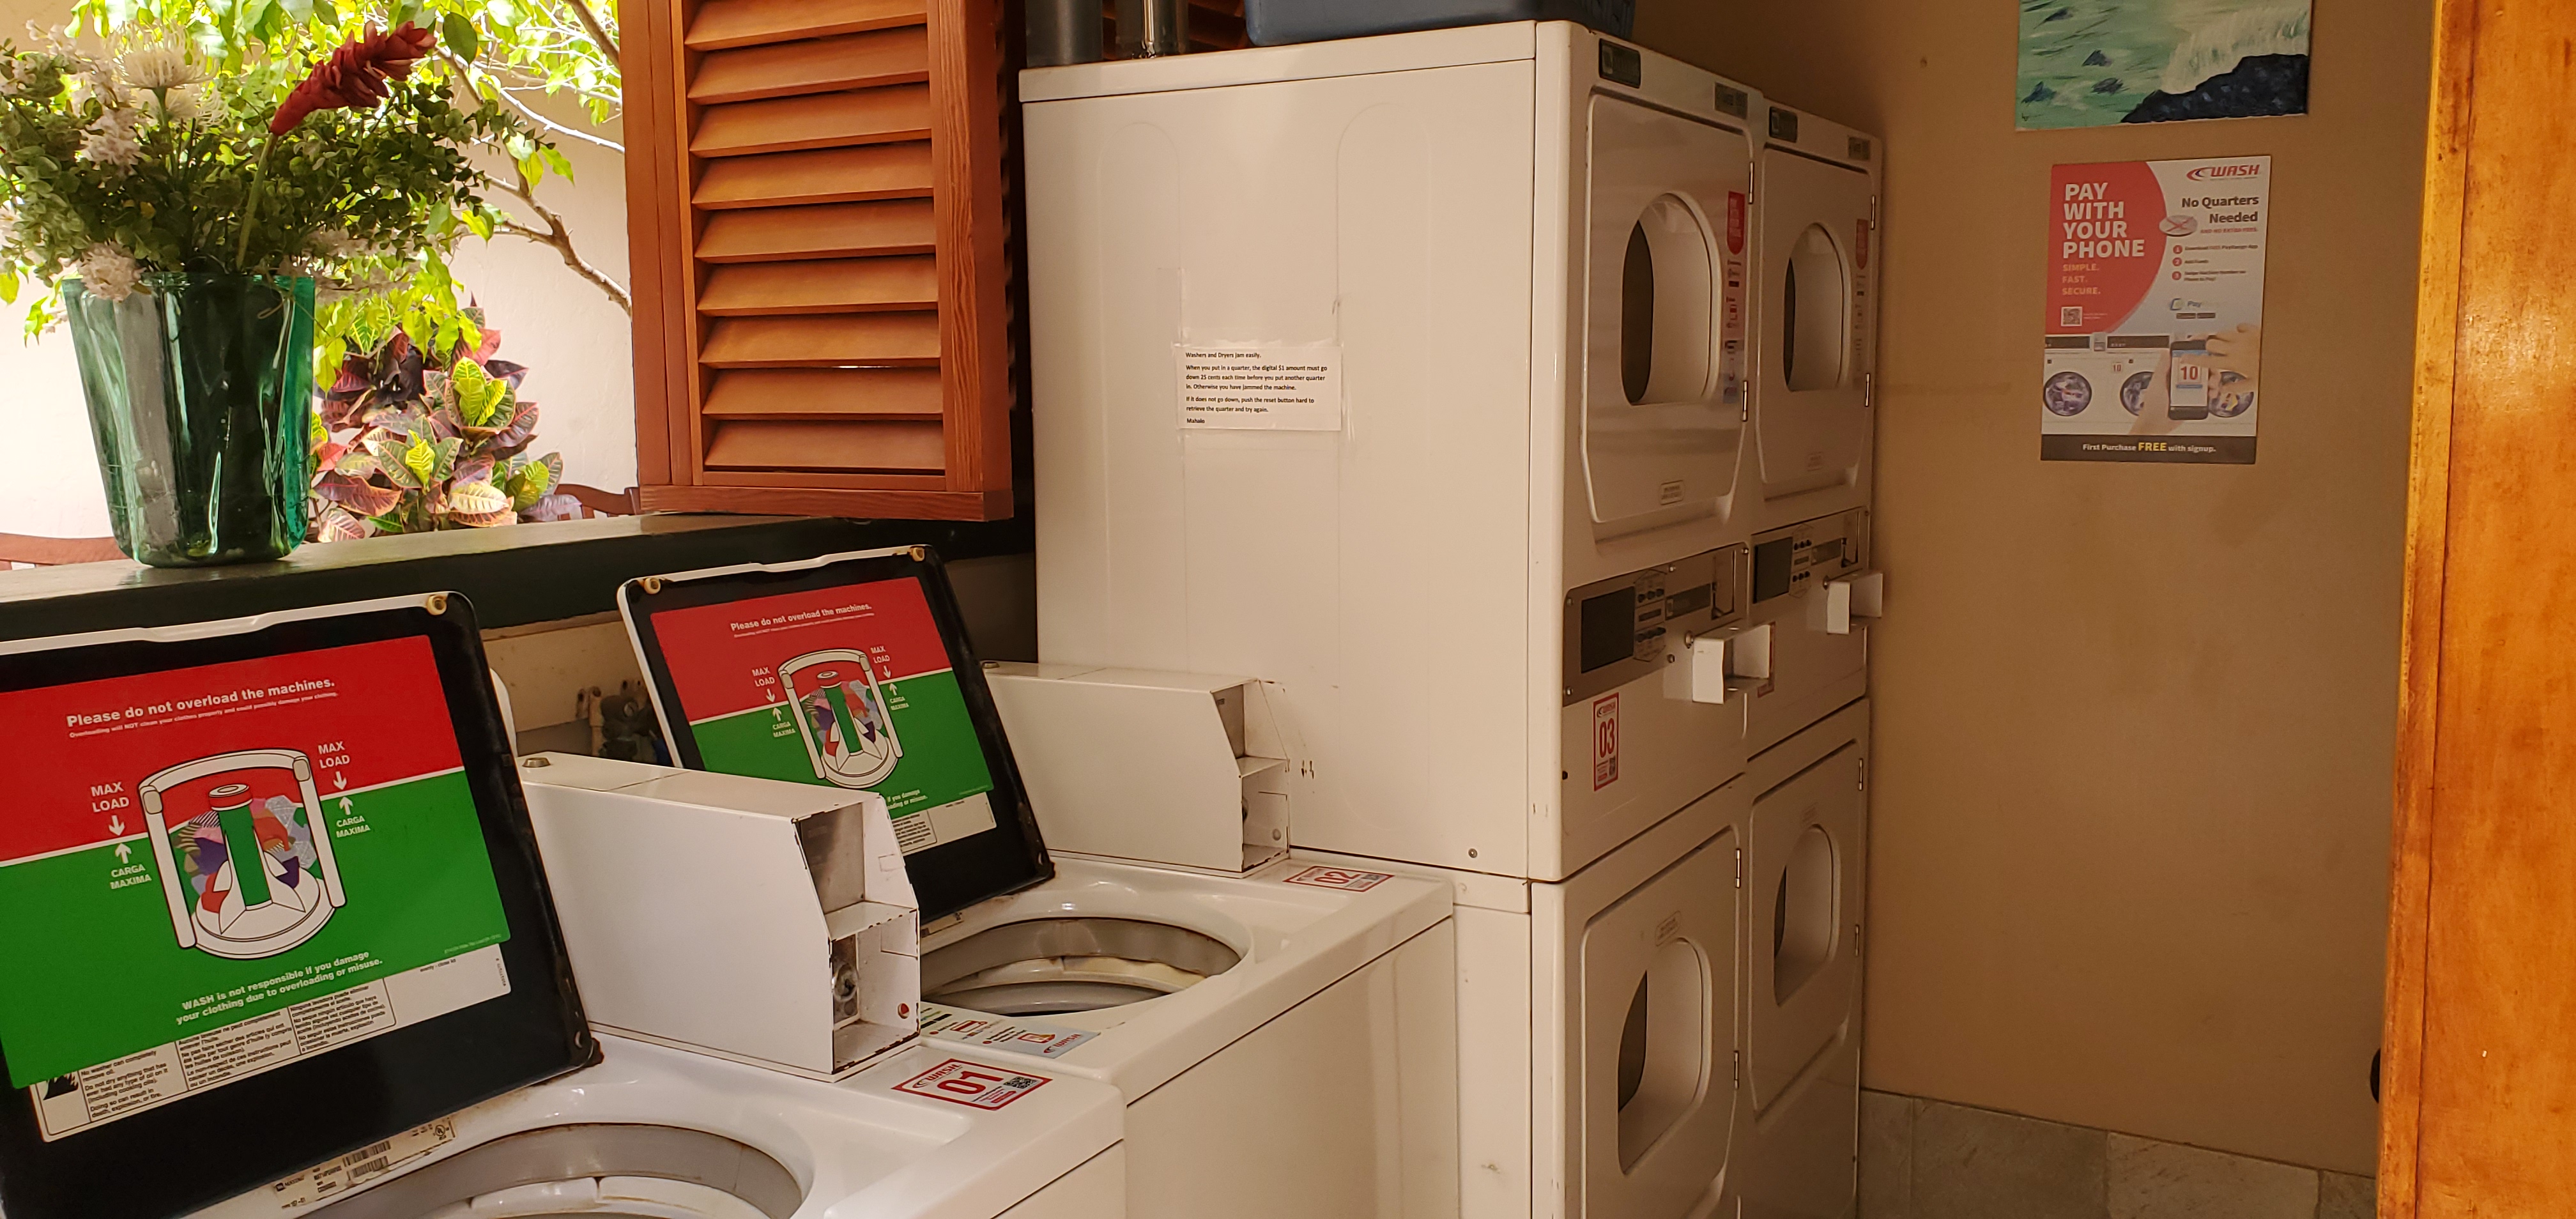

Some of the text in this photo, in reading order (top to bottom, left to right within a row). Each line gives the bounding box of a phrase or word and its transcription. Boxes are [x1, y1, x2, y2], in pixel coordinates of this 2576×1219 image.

[2211, 165, 2260, 177] WASH
[2065, 183, 2108, 201] PAY
[2182, 196, 2259, 208] No Quarters
[2064, 201, 2124, 220] WITH
[2209, 211, 2258, 223] Needed
[2063, 221, 2127, 239] YOUR
[2063, 240, 2144, 258] PHONE
[2063, 263, 2099, 272] SIMPLE.
[2180, 365, 2198, 381] 10
[2138, 442, 2167, 451] FREE
[2188, 445, 2216, 453] signup.
[730, 621, 759, 631] Please
[788, 610, 820, 622] overload
[835, 603, 872, 615] machines.
[873, 655, 891, 663] LOAD
[752, 666, 771, 677] MAX
[754, 677, 775, 687] LOAD
[66, 678, 335, 727] Please do not overload the machines.
[1599, 717, 1614, 758] 03
[318, 741, 345, 755] MAX
[319, 755, 350, 769] LOAD
[91, 782, 124, 797] MAX
[92, 797, 129, 813] LOAD
[336, 815, 365, 827] CARGA
[336, 824, 371, 838] MAXIMA
[111, 864, 146, 878] CARGA
[1314, 871, 1361, 884] 02
[110, 874, 152, 889] MAXIMA
[182, 951, 369, 1010] WASH is not responsible if you damage
[176, 958, 383, 1025] your clothing due to overloading or misuse.
[91, 1064, 112, 1073] washer
[117, 1070, 142, 1081] anything
[926, 1064, 962, 1082] WASH
[125, 1077, 138, 1087] type
[937, 1071, 1004, 1094] 01
[90, 1102, 109, 1112] Doing
[130, 1090, 147, 1100] result
